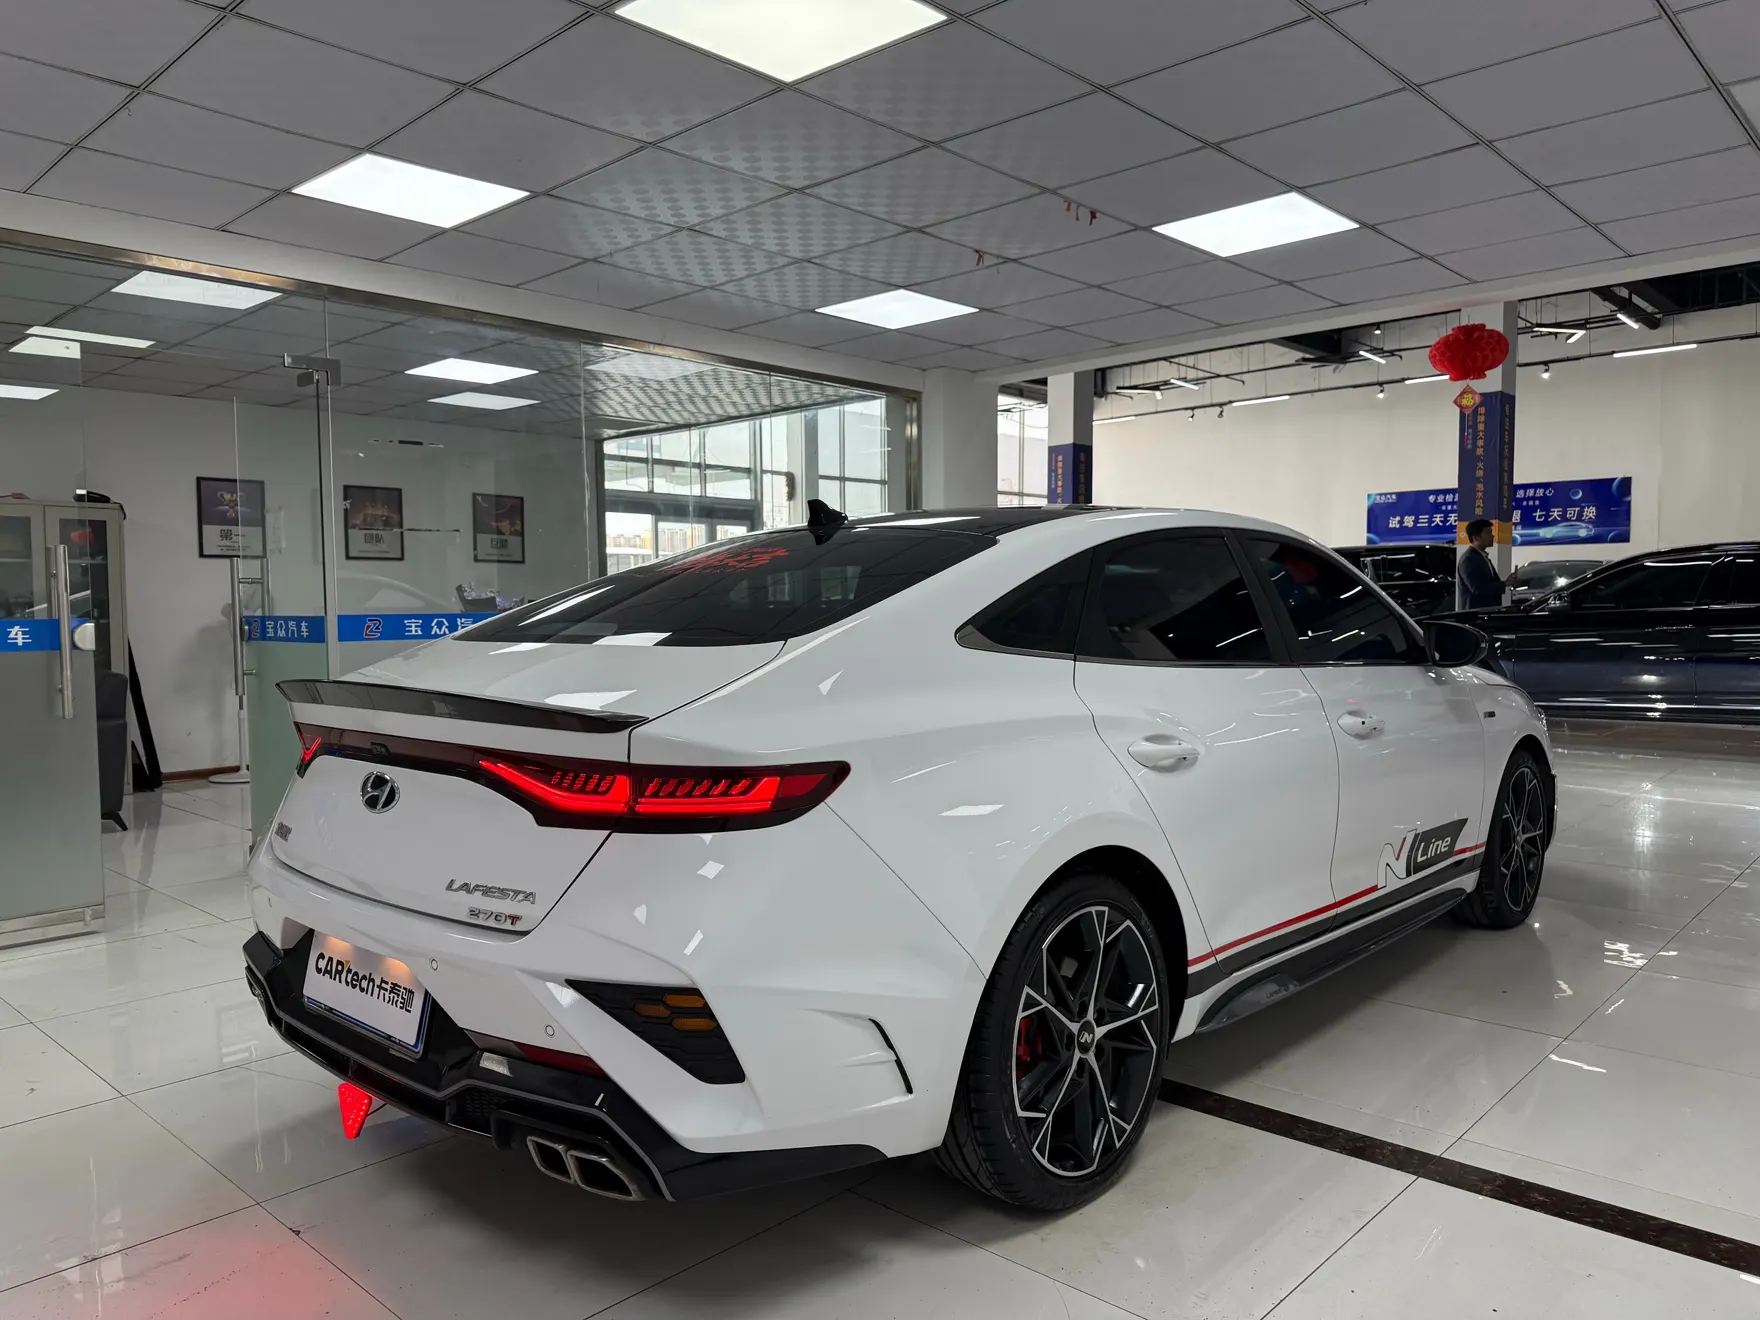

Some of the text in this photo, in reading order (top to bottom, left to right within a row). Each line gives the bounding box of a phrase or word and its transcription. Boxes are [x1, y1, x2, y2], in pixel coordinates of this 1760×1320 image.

[1515, 486, 1555, 499] 选择放心
[1531, 504, 1598, 522] 七天可换
[6, 625, 33, 647] 车
[265, 619, 310, 639] 宝众汽车
[1416, 836, 1452, 863] Line
[445, 878, 537, 905] LAFESTA
[467, 906, 523, 927] 270T
[314, 951, 416, 1014] CARtech 卡泰驰
